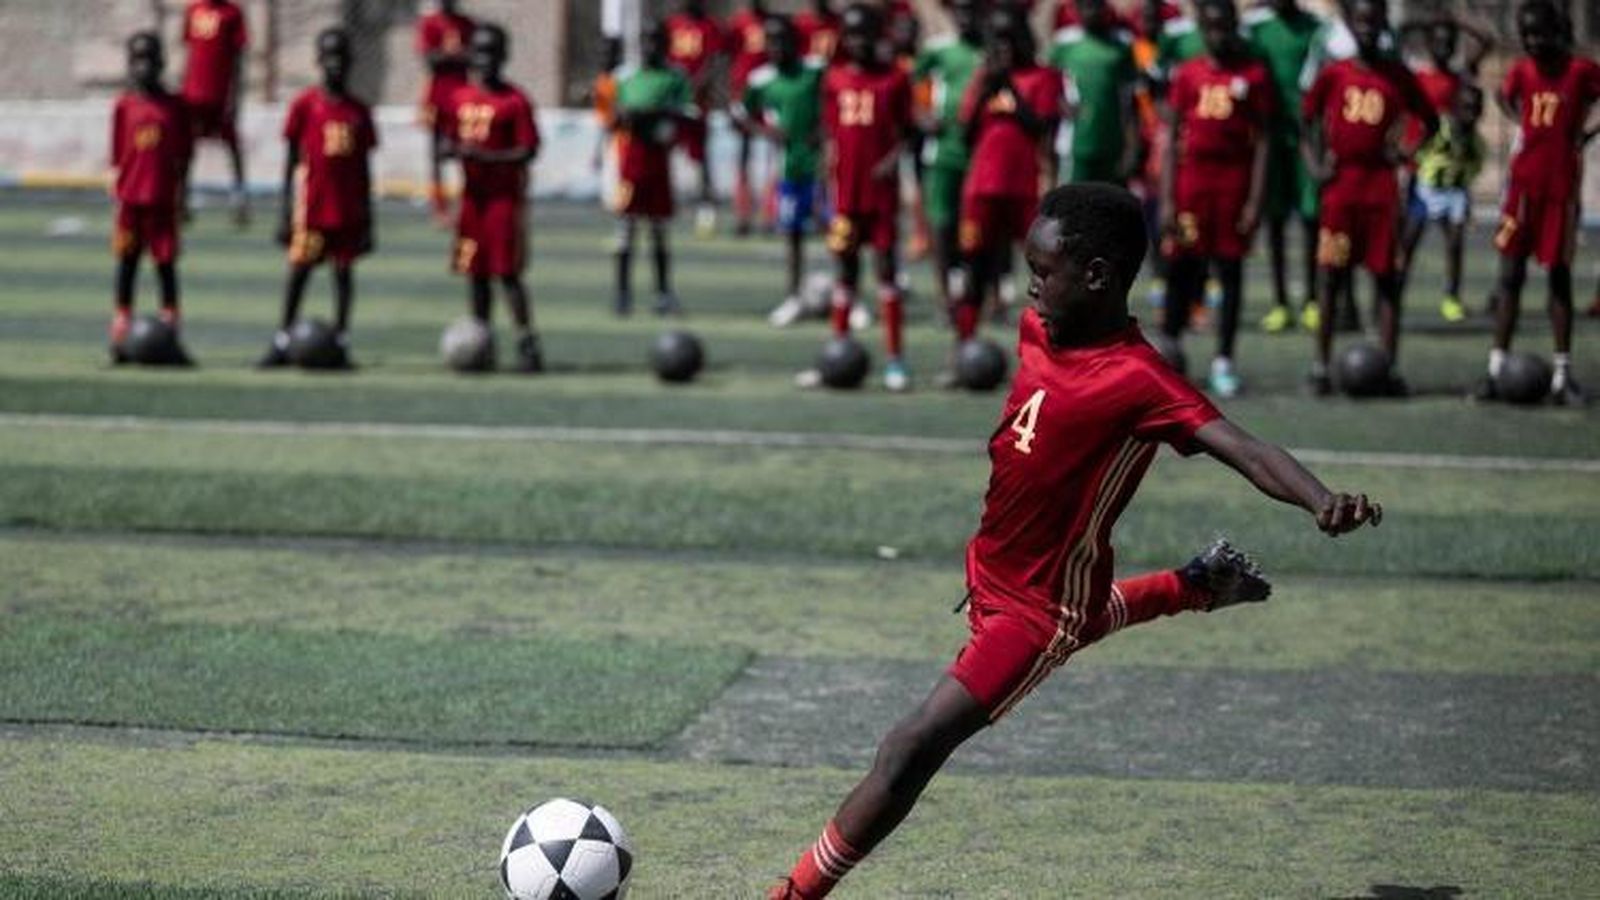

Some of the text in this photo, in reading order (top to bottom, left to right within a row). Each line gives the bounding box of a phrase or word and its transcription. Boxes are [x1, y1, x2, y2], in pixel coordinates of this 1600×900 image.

[1342, 85, 1385, 126] 30
[1531, 91, 1560, 128] 17
[1011, 388, 1046, 455] 4
